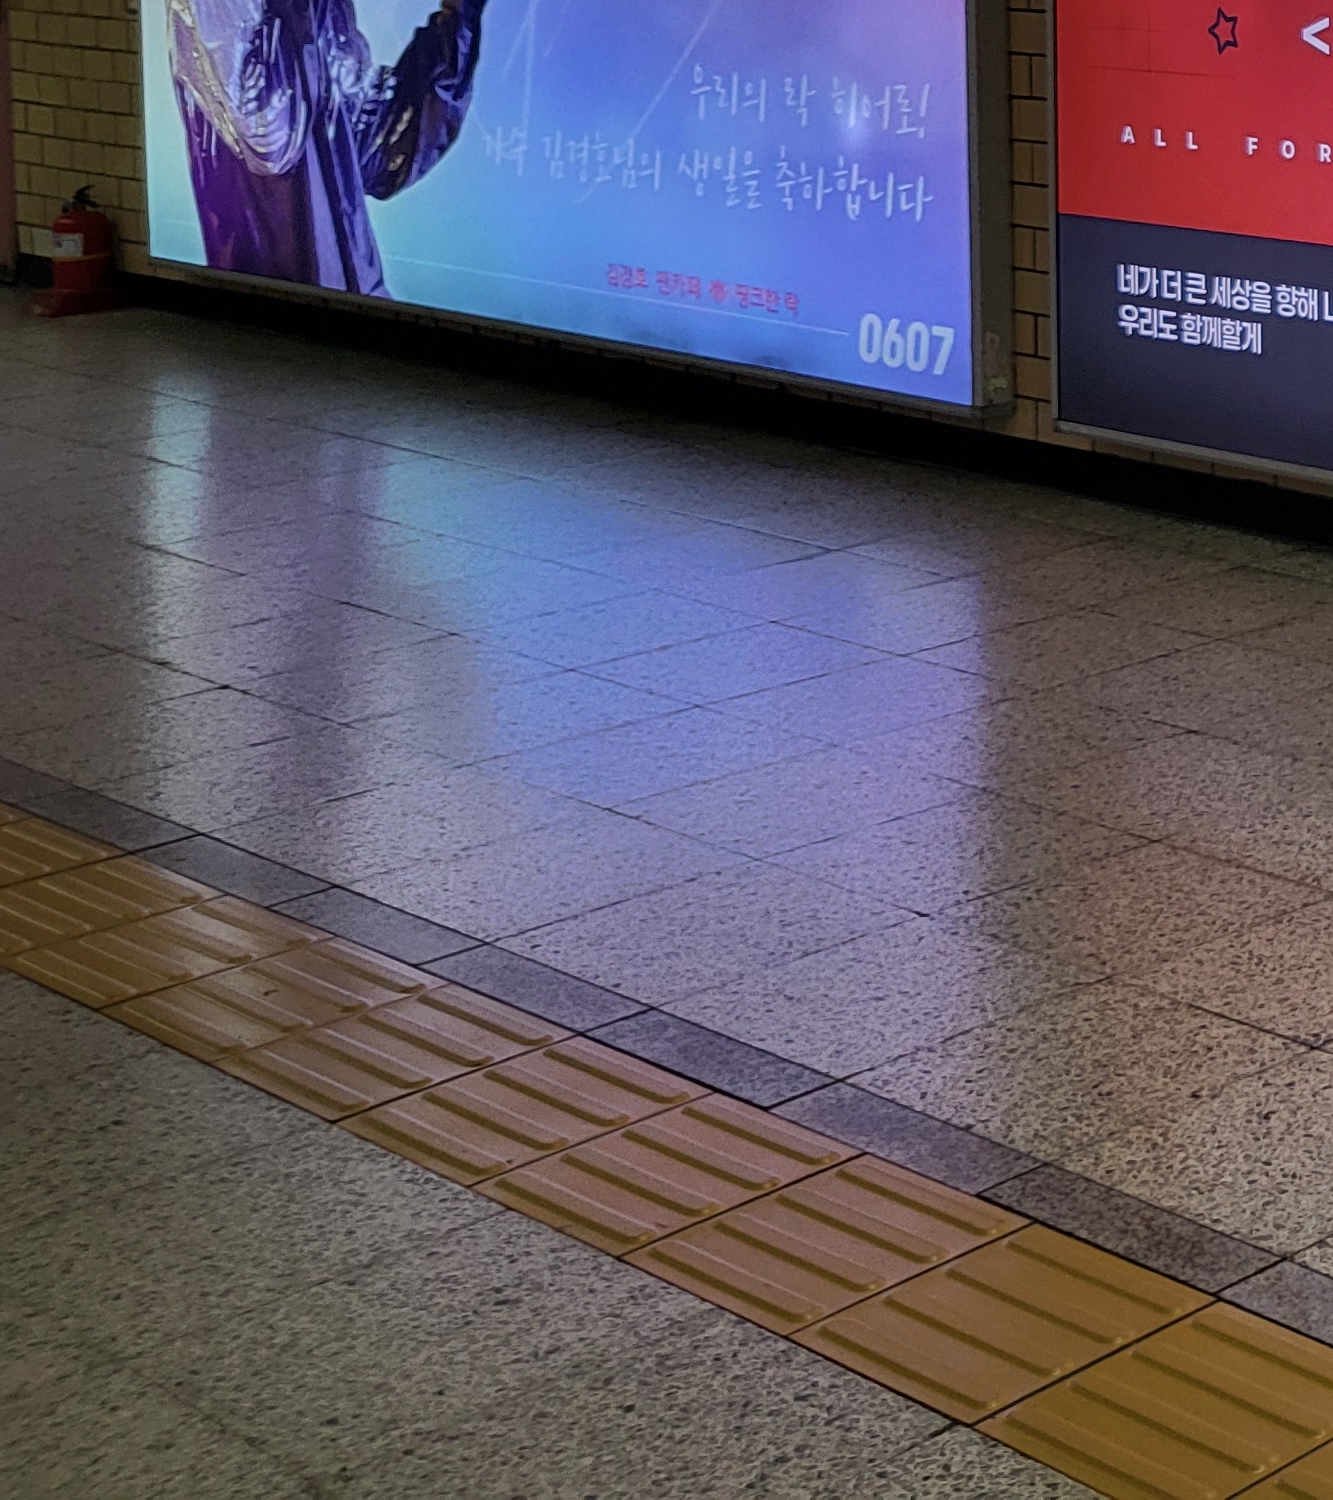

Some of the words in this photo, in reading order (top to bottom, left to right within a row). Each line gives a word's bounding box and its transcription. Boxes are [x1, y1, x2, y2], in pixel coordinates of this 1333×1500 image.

[690, 64, 767, 122] 우리의
[785, 75, 816, 127] 락
[830, 77, 930, 139] 히어로!
[1120, 125, 1200, 152] ALL
[1245, 136, 1333, 164] FOR
[541, 129, 662, 192] 김경호님의
[677, 146, 763, 211] 생일을
[775, 145, 935, 222] 축하합니다
[1117, 263, 1159, 299] 네가
[1161, 270, 1182, 301] 더
[1184, 273, 1207, 306] 큰
[1211, 275, 1272, 315] 세상을
[1276, 284, 1319, 322] 향해
[859, 312, 956, 376] 0607
[1117, 304, 1179, 341] 우리도
[1180, 312, 1264, 356] 함께할게
